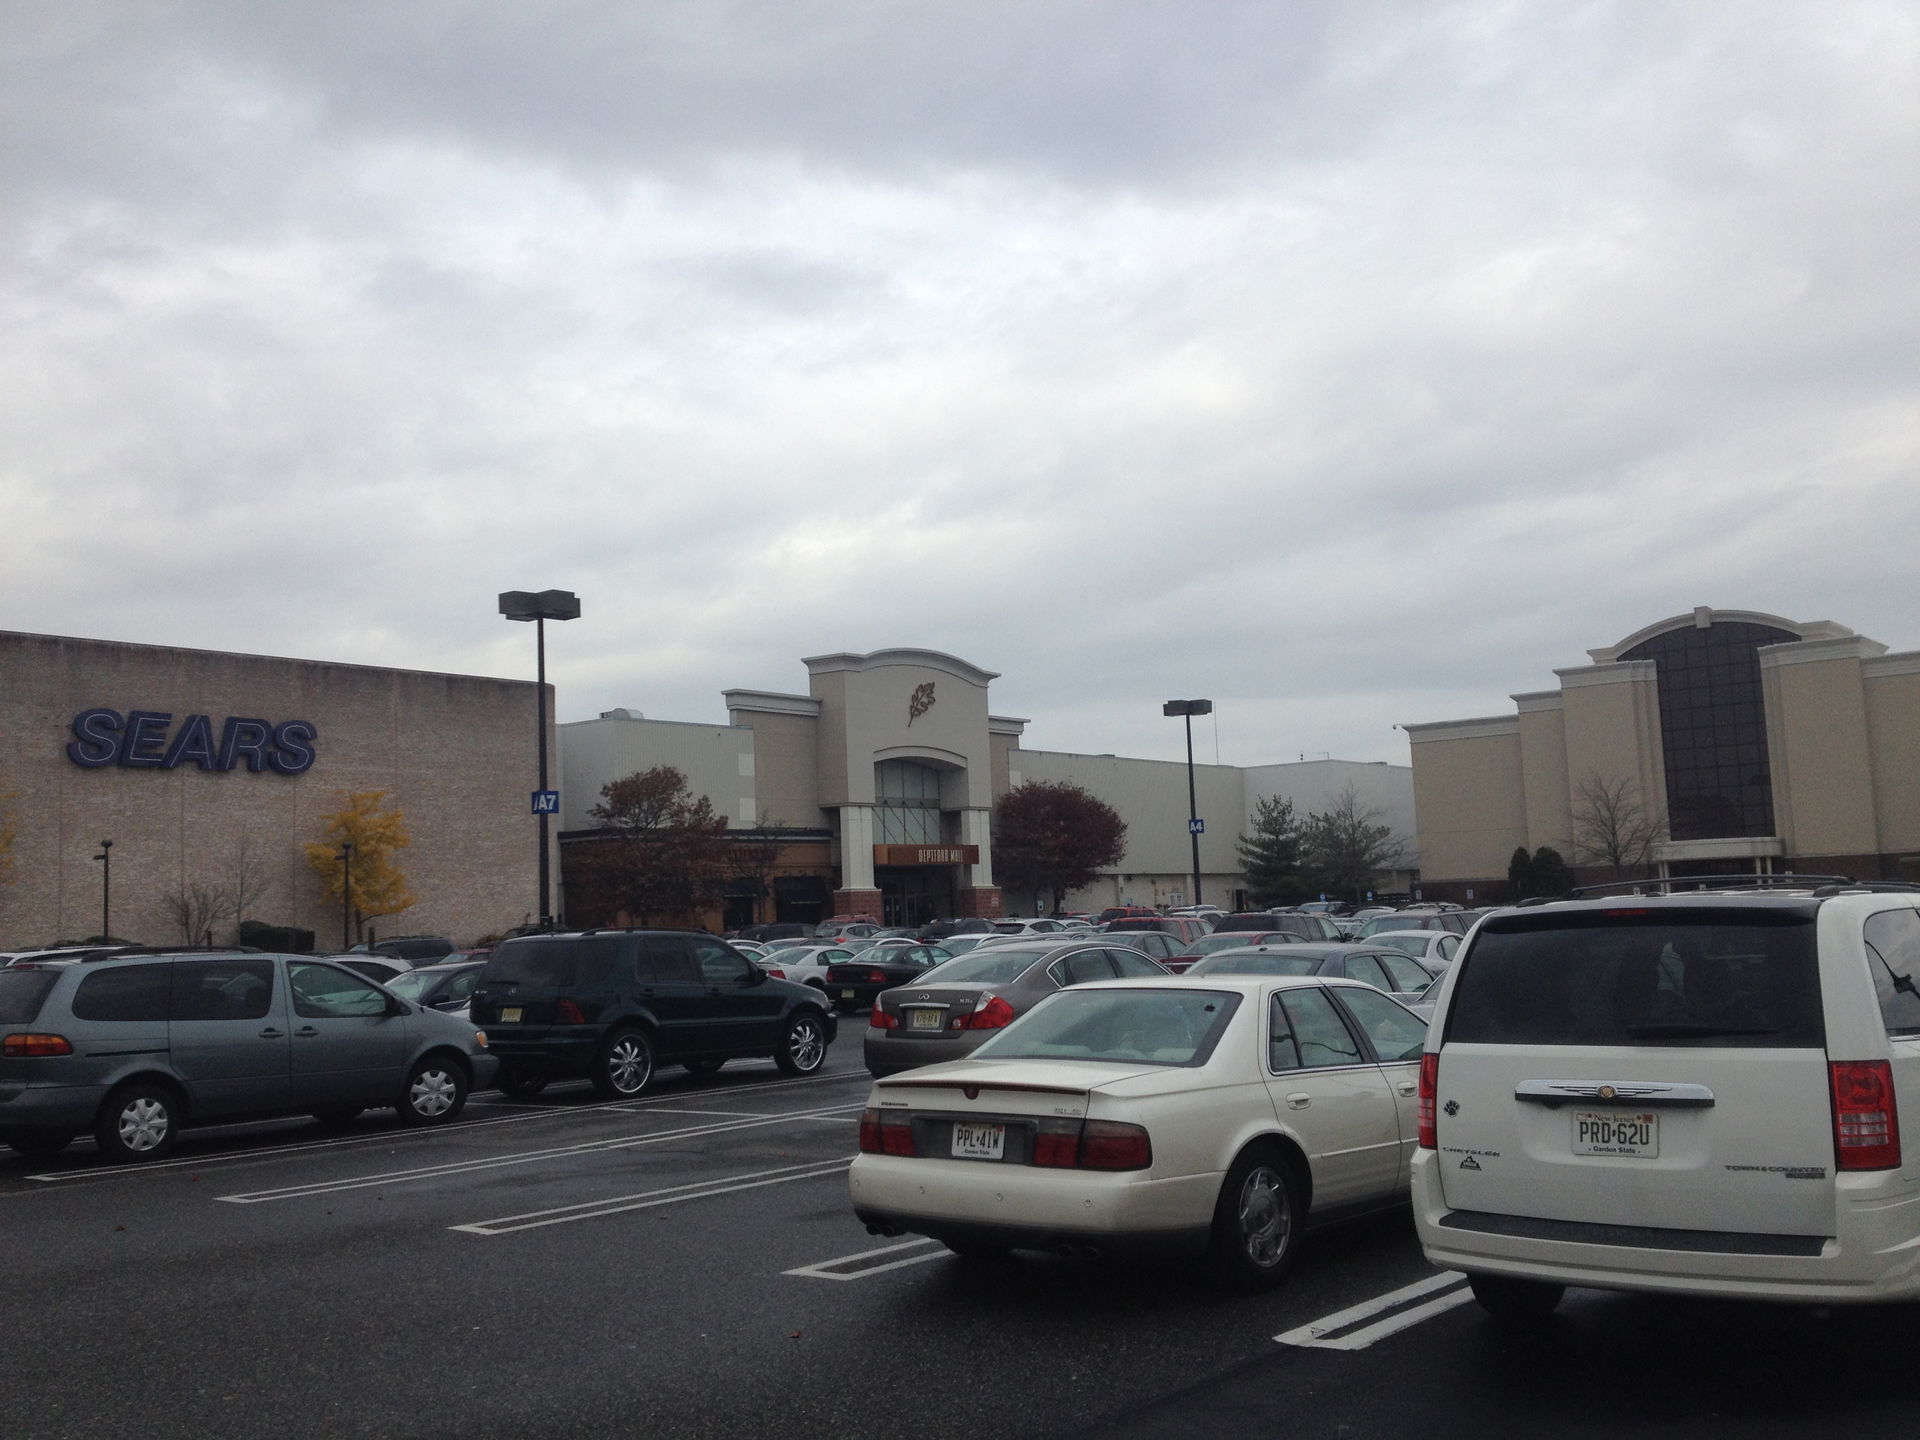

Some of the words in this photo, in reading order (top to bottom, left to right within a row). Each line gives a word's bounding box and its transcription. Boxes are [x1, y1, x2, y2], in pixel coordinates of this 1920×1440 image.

[66, 708, 318, 776] SEARS
[538, 794, 556, 811] A7
[1190, 821, 1203, 832] A4
